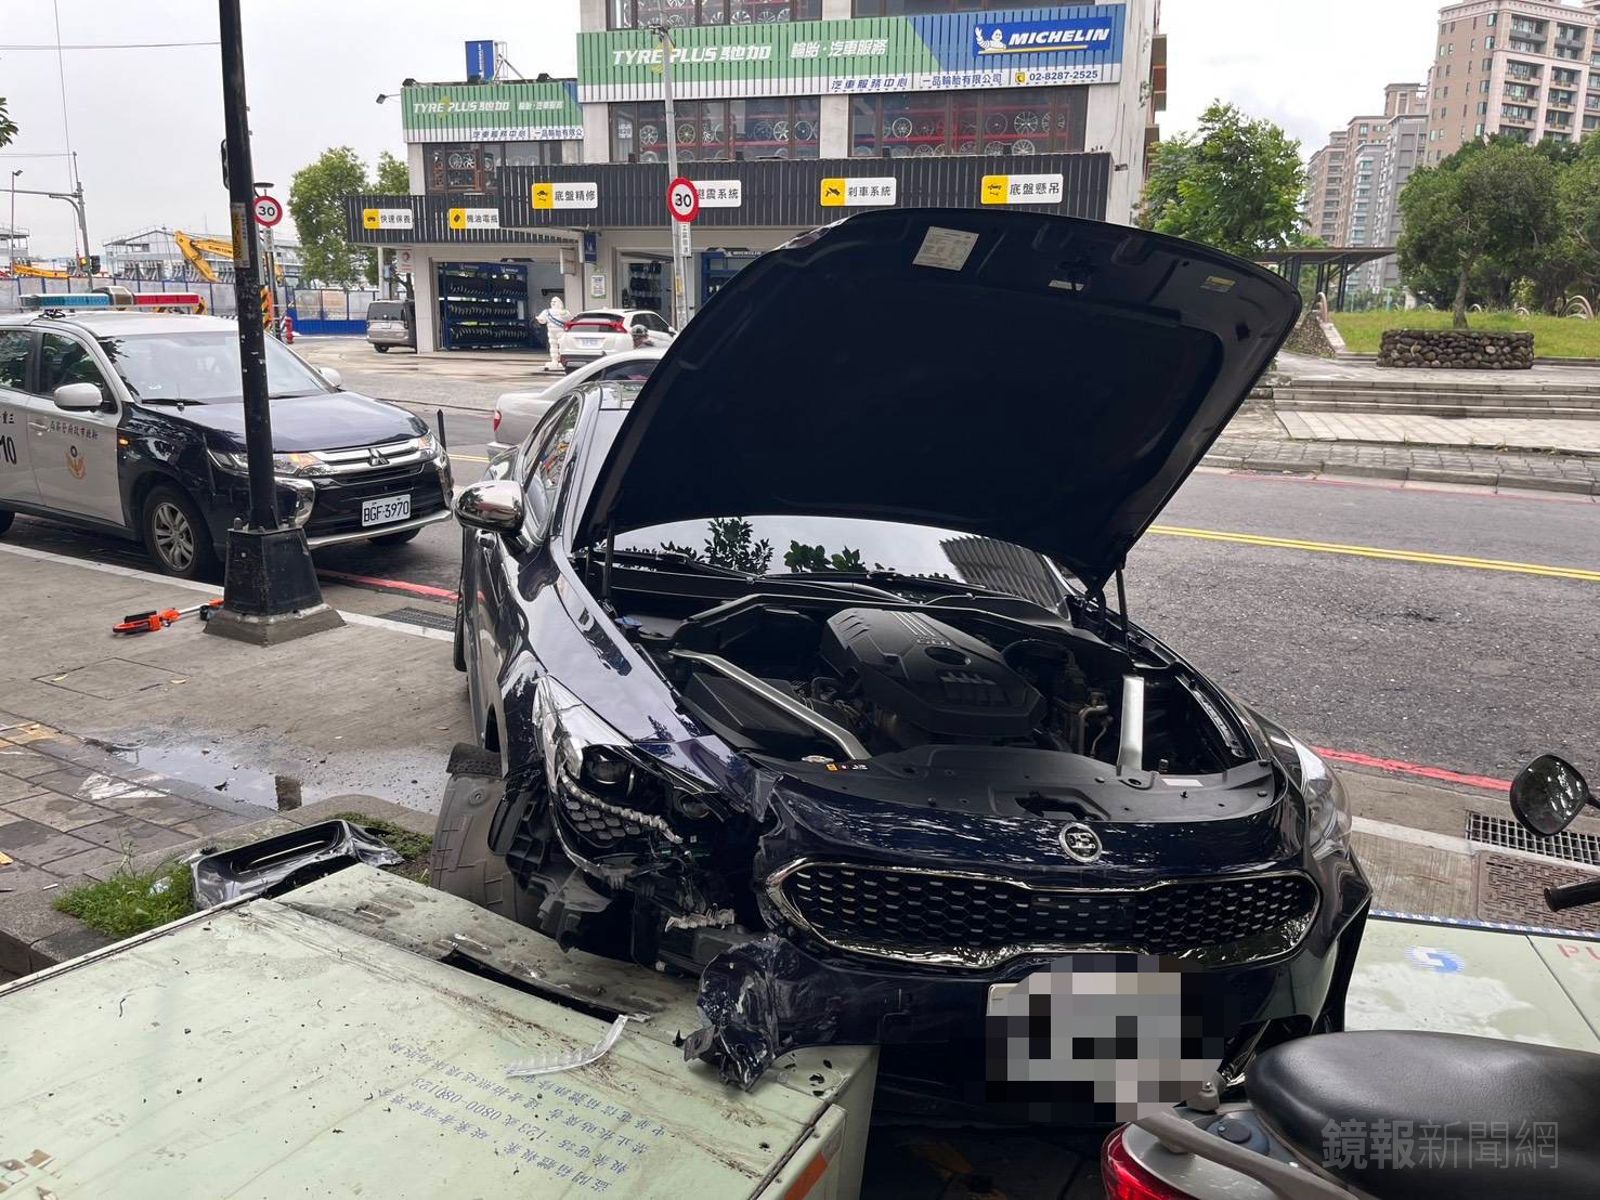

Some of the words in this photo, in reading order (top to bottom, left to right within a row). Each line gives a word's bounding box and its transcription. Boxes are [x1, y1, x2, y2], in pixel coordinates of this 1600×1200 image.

[1008, 28, 1111, 46] MICHELIN
[612, 48, 663, 65] TYRE
[668, 46, 718, 64] PLUS
[719, 44, 772, 62] 馳加
[922, 73, 1003, 87] 一品輪胎有限公司
[1028, 69, 1099, 82] 02-8287-2525
[831, 77, 909, 90] 汽車服務中心
[413, 102, 445, 113] TYRE
[447, 101, 478, 113] PLUS
[554, 190, 596, 202] 底盤精修
[1009, 182, 1060, 196] 底盤懸吊
[675, 193, 692, 208] 30
[258, 205, 275, 217] 30
[380, 214, 411, 224] 快速保養
[363, 500, 410, 522] BGF-3970
